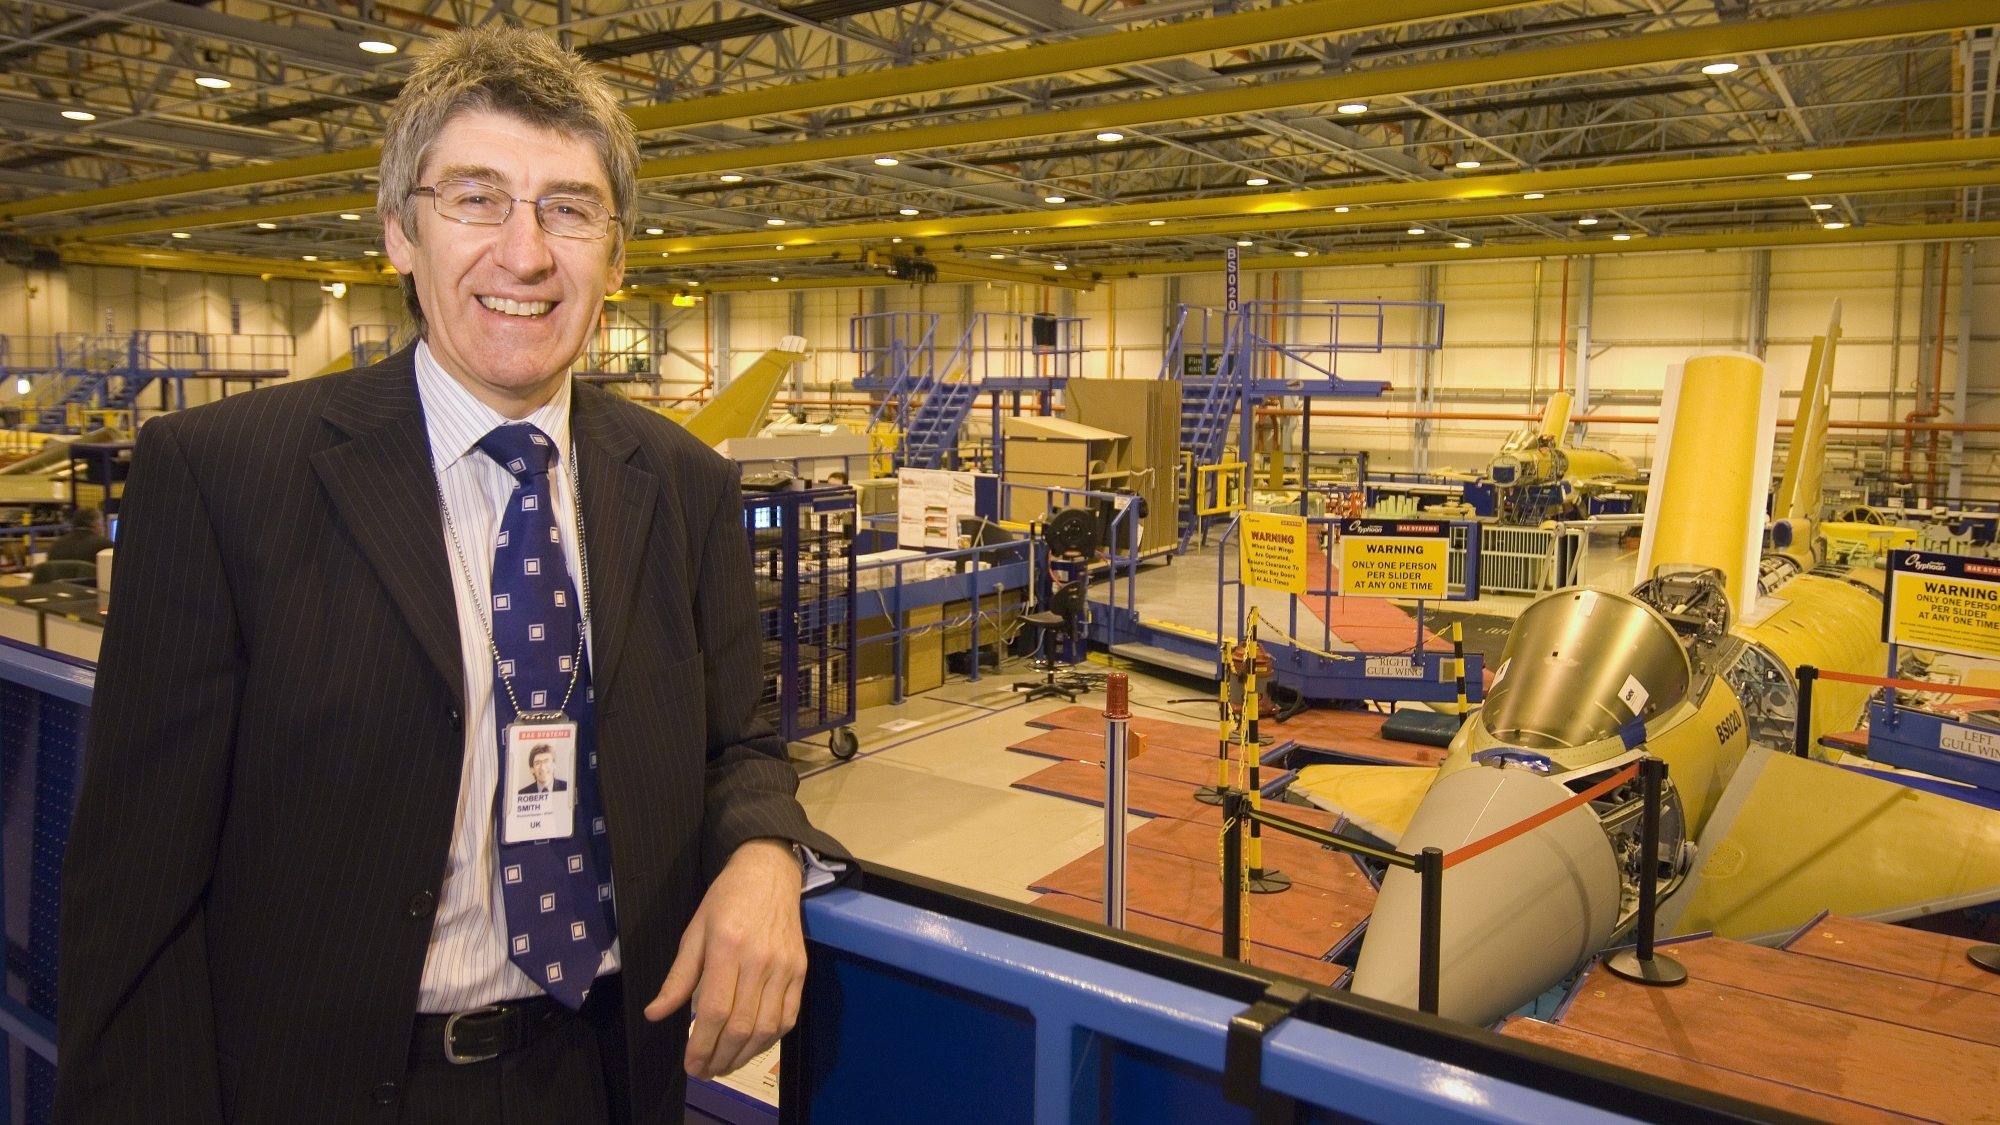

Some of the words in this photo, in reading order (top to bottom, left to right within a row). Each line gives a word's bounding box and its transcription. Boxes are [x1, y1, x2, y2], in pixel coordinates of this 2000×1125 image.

[1227, 248, 1237, 311] BS020
[1188, 356, 1202, 364] Fire
[1251, 531, 1295, 544] WARNING
[1278, 546, 1294, 554] Wings
[1366, 544, 1424, 554] WARNING
[1265, 561, 1291, 570] Clearance
[1378, 561, 1396, 569] ONE
[1400, 562, 1437, 570] PERSON
[1915, 561, 1946, 571] Typhoon
[1281, 571, 1296, 579] Doors
[1388, 572, 1421, 580] SLIDER
[1368, 581, 1386, 589] ANY
[1411, 582, 1433, 590] TIME
[1925, 582, 1998, 601] WARNING
[1916, 594, 1939, 603] ONLY
[1942, 597, 1962, 607] ONE
[1931, 605, 1949, 613] PER
[1953, 607, 1987, 619] SLIDER
[1932, 613, 1950, 622] ANY
[1953, 616, 1972, 626] ONE
[1976, 619, 1999, 629] TIME
[1380, 658, 1409, 666] RIGHT
[1367, 667, 1392, 675] GULL
[1395, 668, 1422, 676] WING
[1716, 709, 1741, 745] BS020
[1964, 730, 1994, 745] LEFT
[1942, 737, 1974, 753] GULL
[518, 794, 548, 803] ROBERT
[517, 804, 540, 812] SMITH
